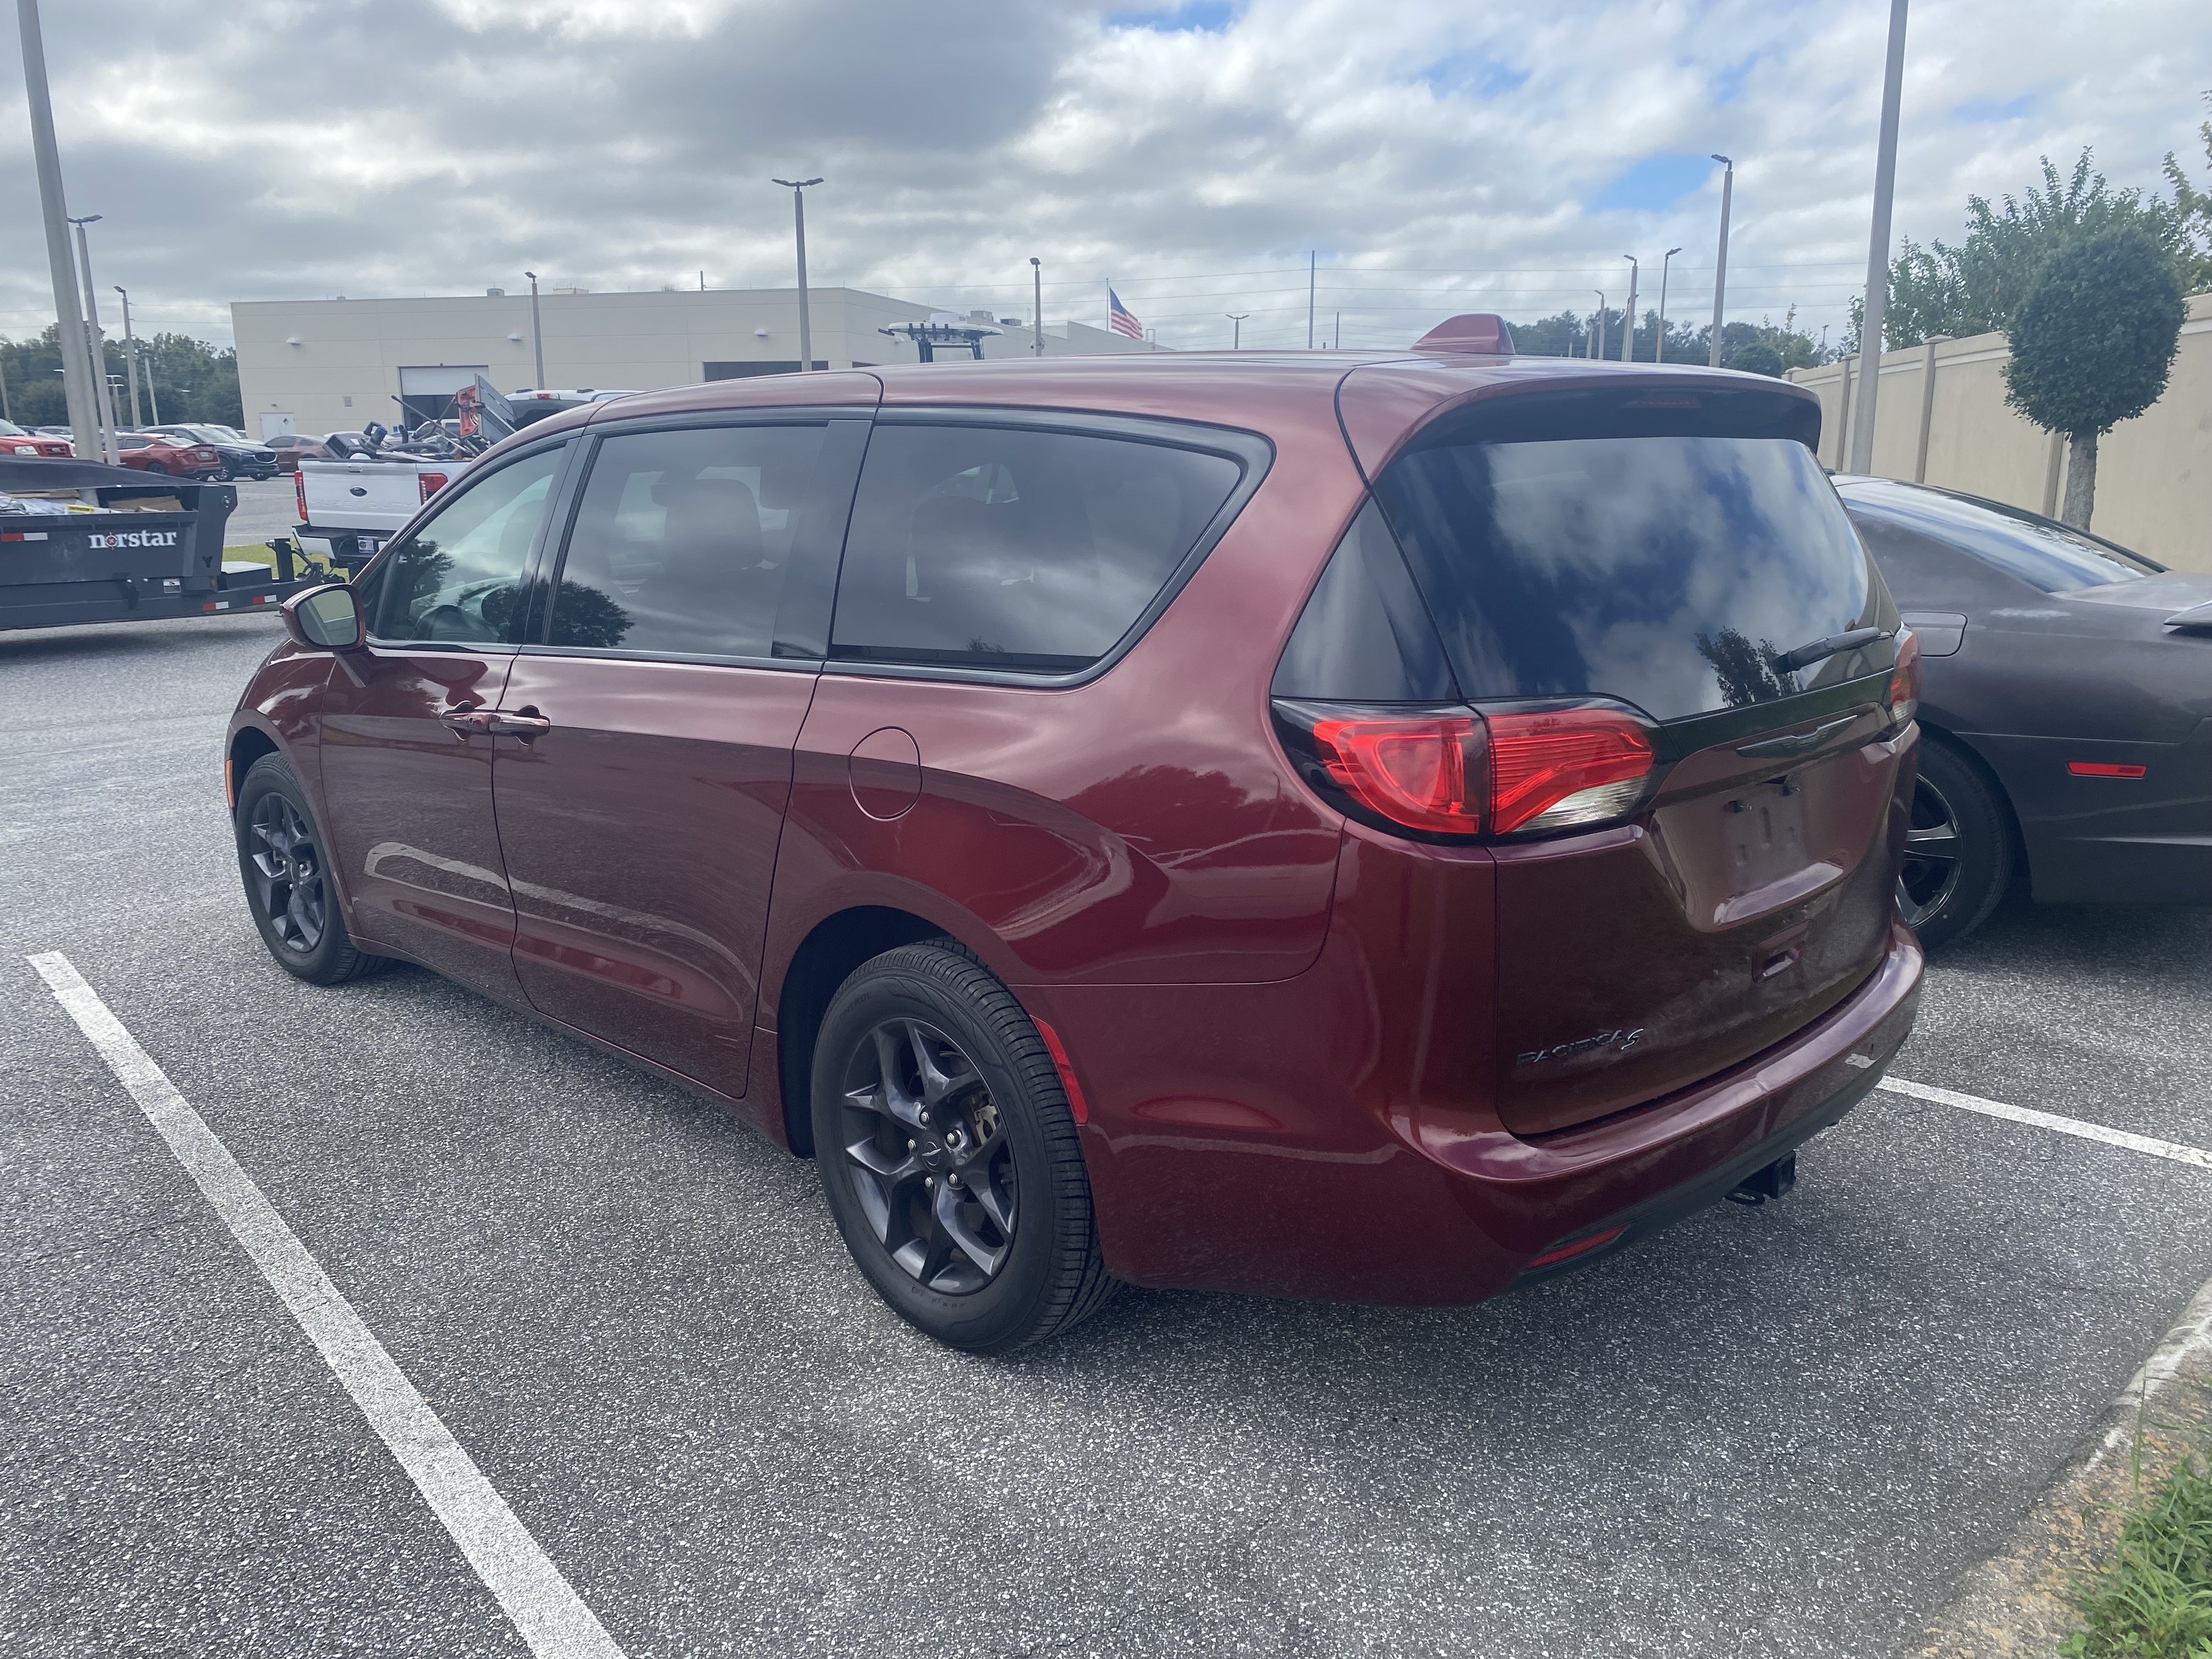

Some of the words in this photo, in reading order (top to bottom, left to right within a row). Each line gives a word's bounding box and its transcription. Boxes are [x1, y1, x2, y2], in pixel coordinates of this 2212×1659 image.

[312, 499, 365, 508] SUPER
[368, 501, 413, 510] DUTY
[88, 529, 177, 549] norstar
[1516, 1029, 1622, 1066] PACIFICA
[1620, 1028, 1644, 1051] S
